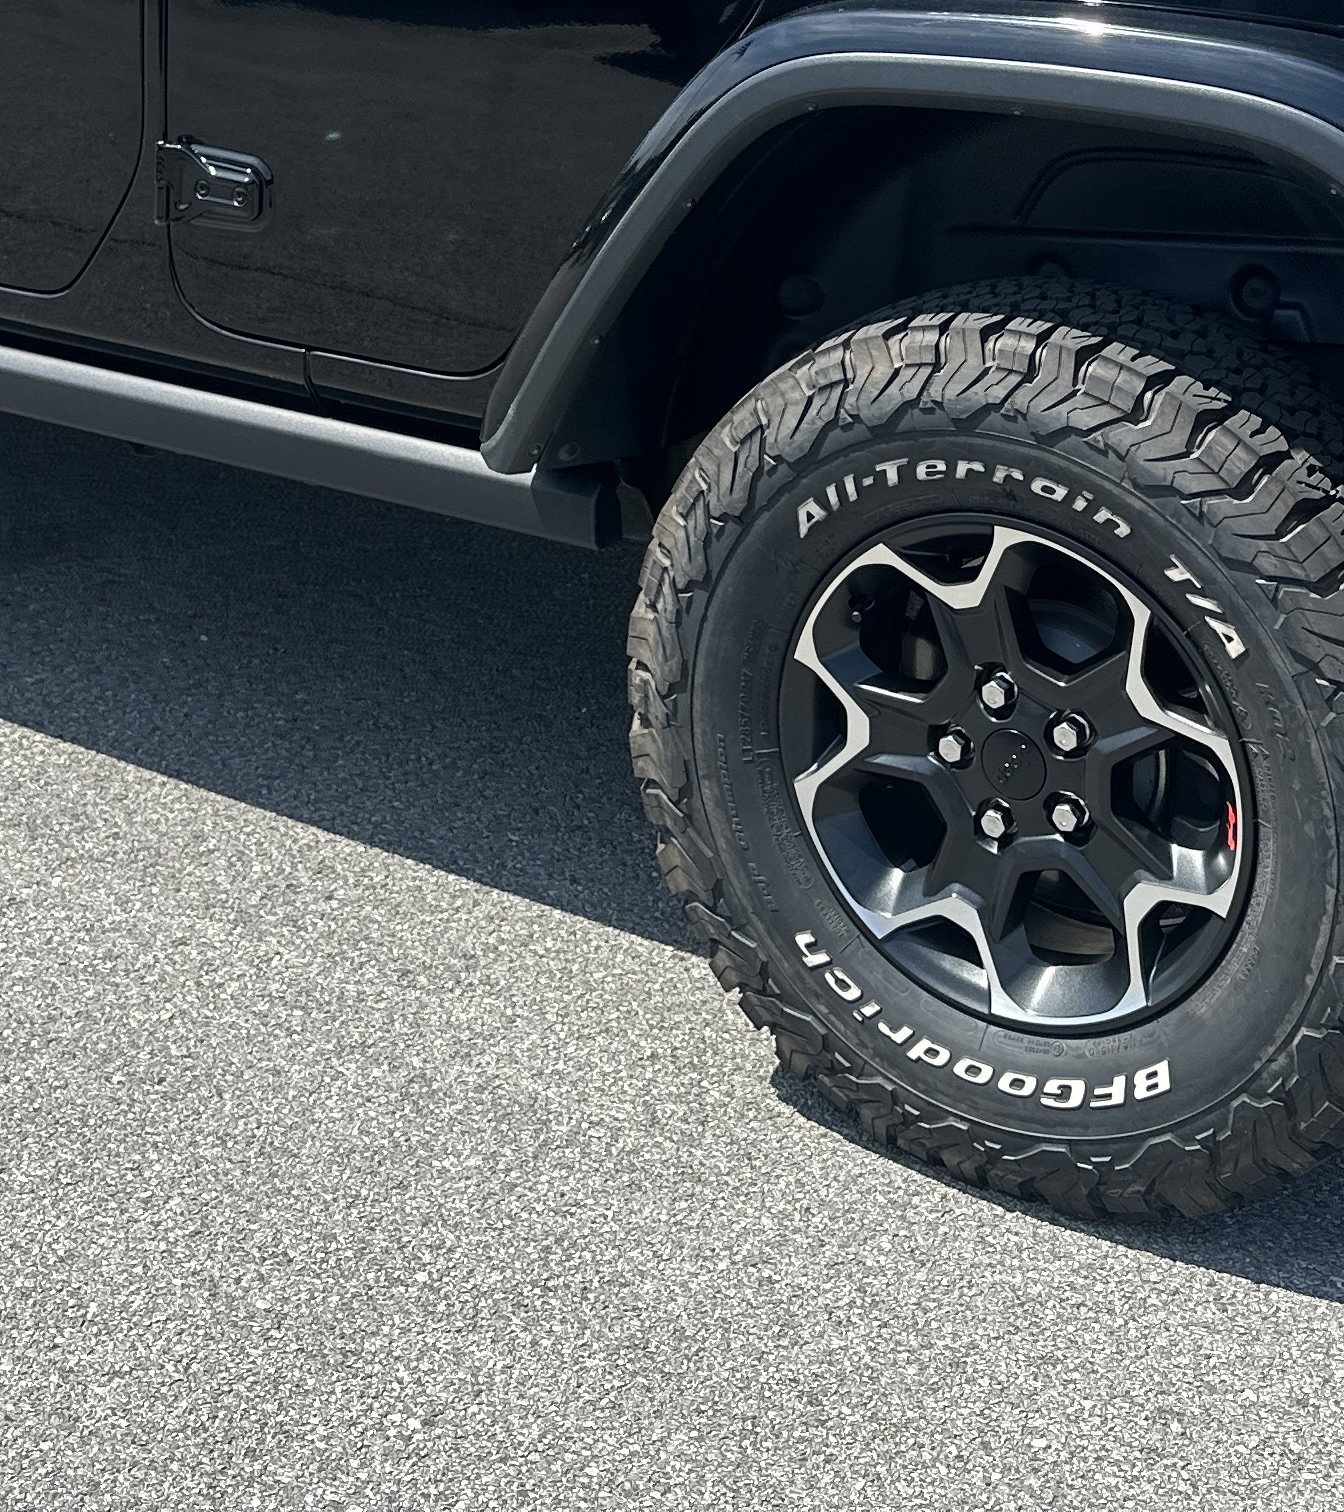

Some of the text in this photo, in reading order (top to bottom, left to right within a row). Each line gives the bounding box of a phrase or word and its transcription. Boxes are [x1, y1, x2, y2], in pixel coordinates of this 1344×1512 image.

[796, 456, 1248, 660] All-Terrain T/A
[794, 930, 1172, 1110] BFGoodrich
